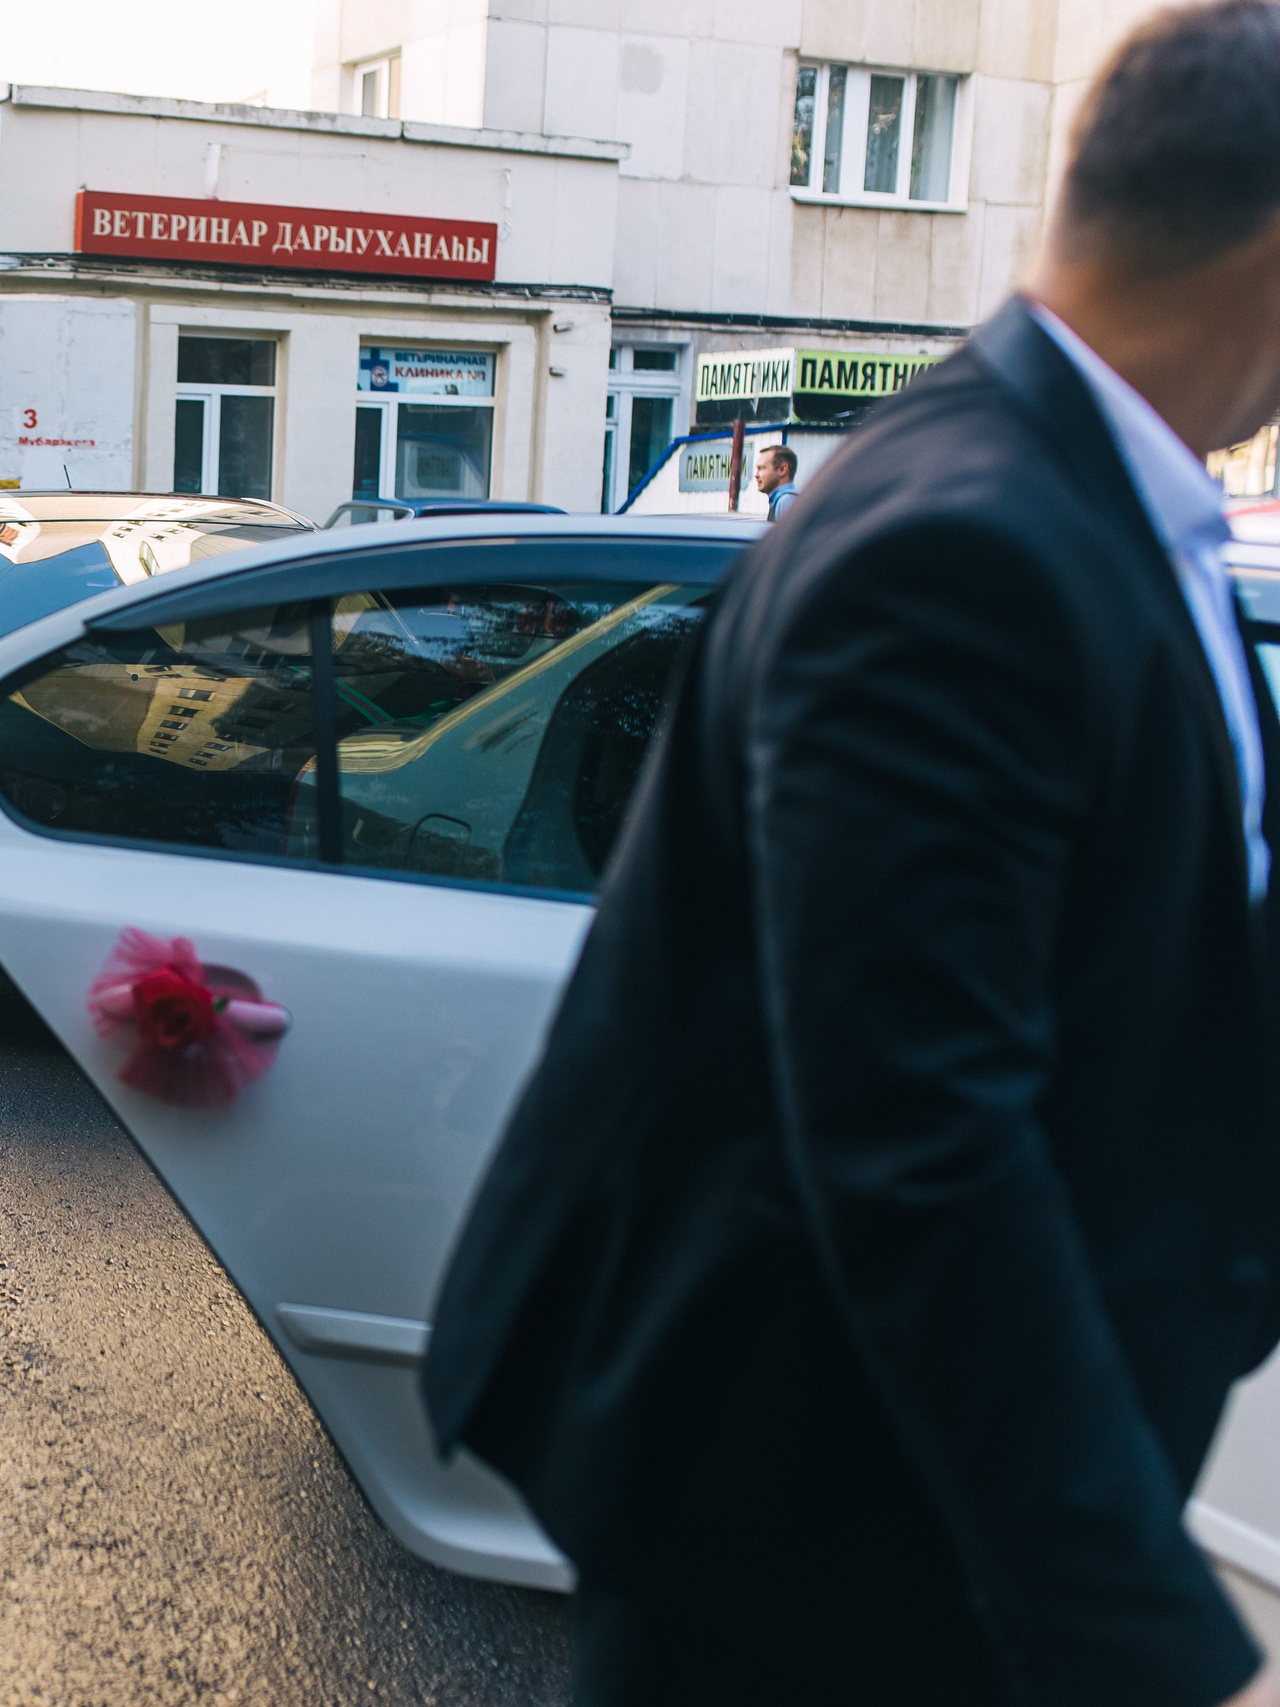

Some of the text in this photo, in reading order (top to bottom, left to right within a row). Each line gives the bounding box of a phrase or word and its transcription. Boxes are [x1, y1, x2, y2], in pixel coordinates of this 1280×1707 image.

[93, 208, 268, 248] ВЕТЕРИНАР
[394, 352, 487, 366] ВЕТЕРИНАРНАЯ
[395, 366, 464, 380] КЛИНИКА
[700, 359, 790, 396] ПАМЯТНИКИ
[800, 357, 944, 392] ПАМЯТНИ
[23, 408, 38, 429] 3
[686, 453, 748, 480] ПАМЯТНИИ
